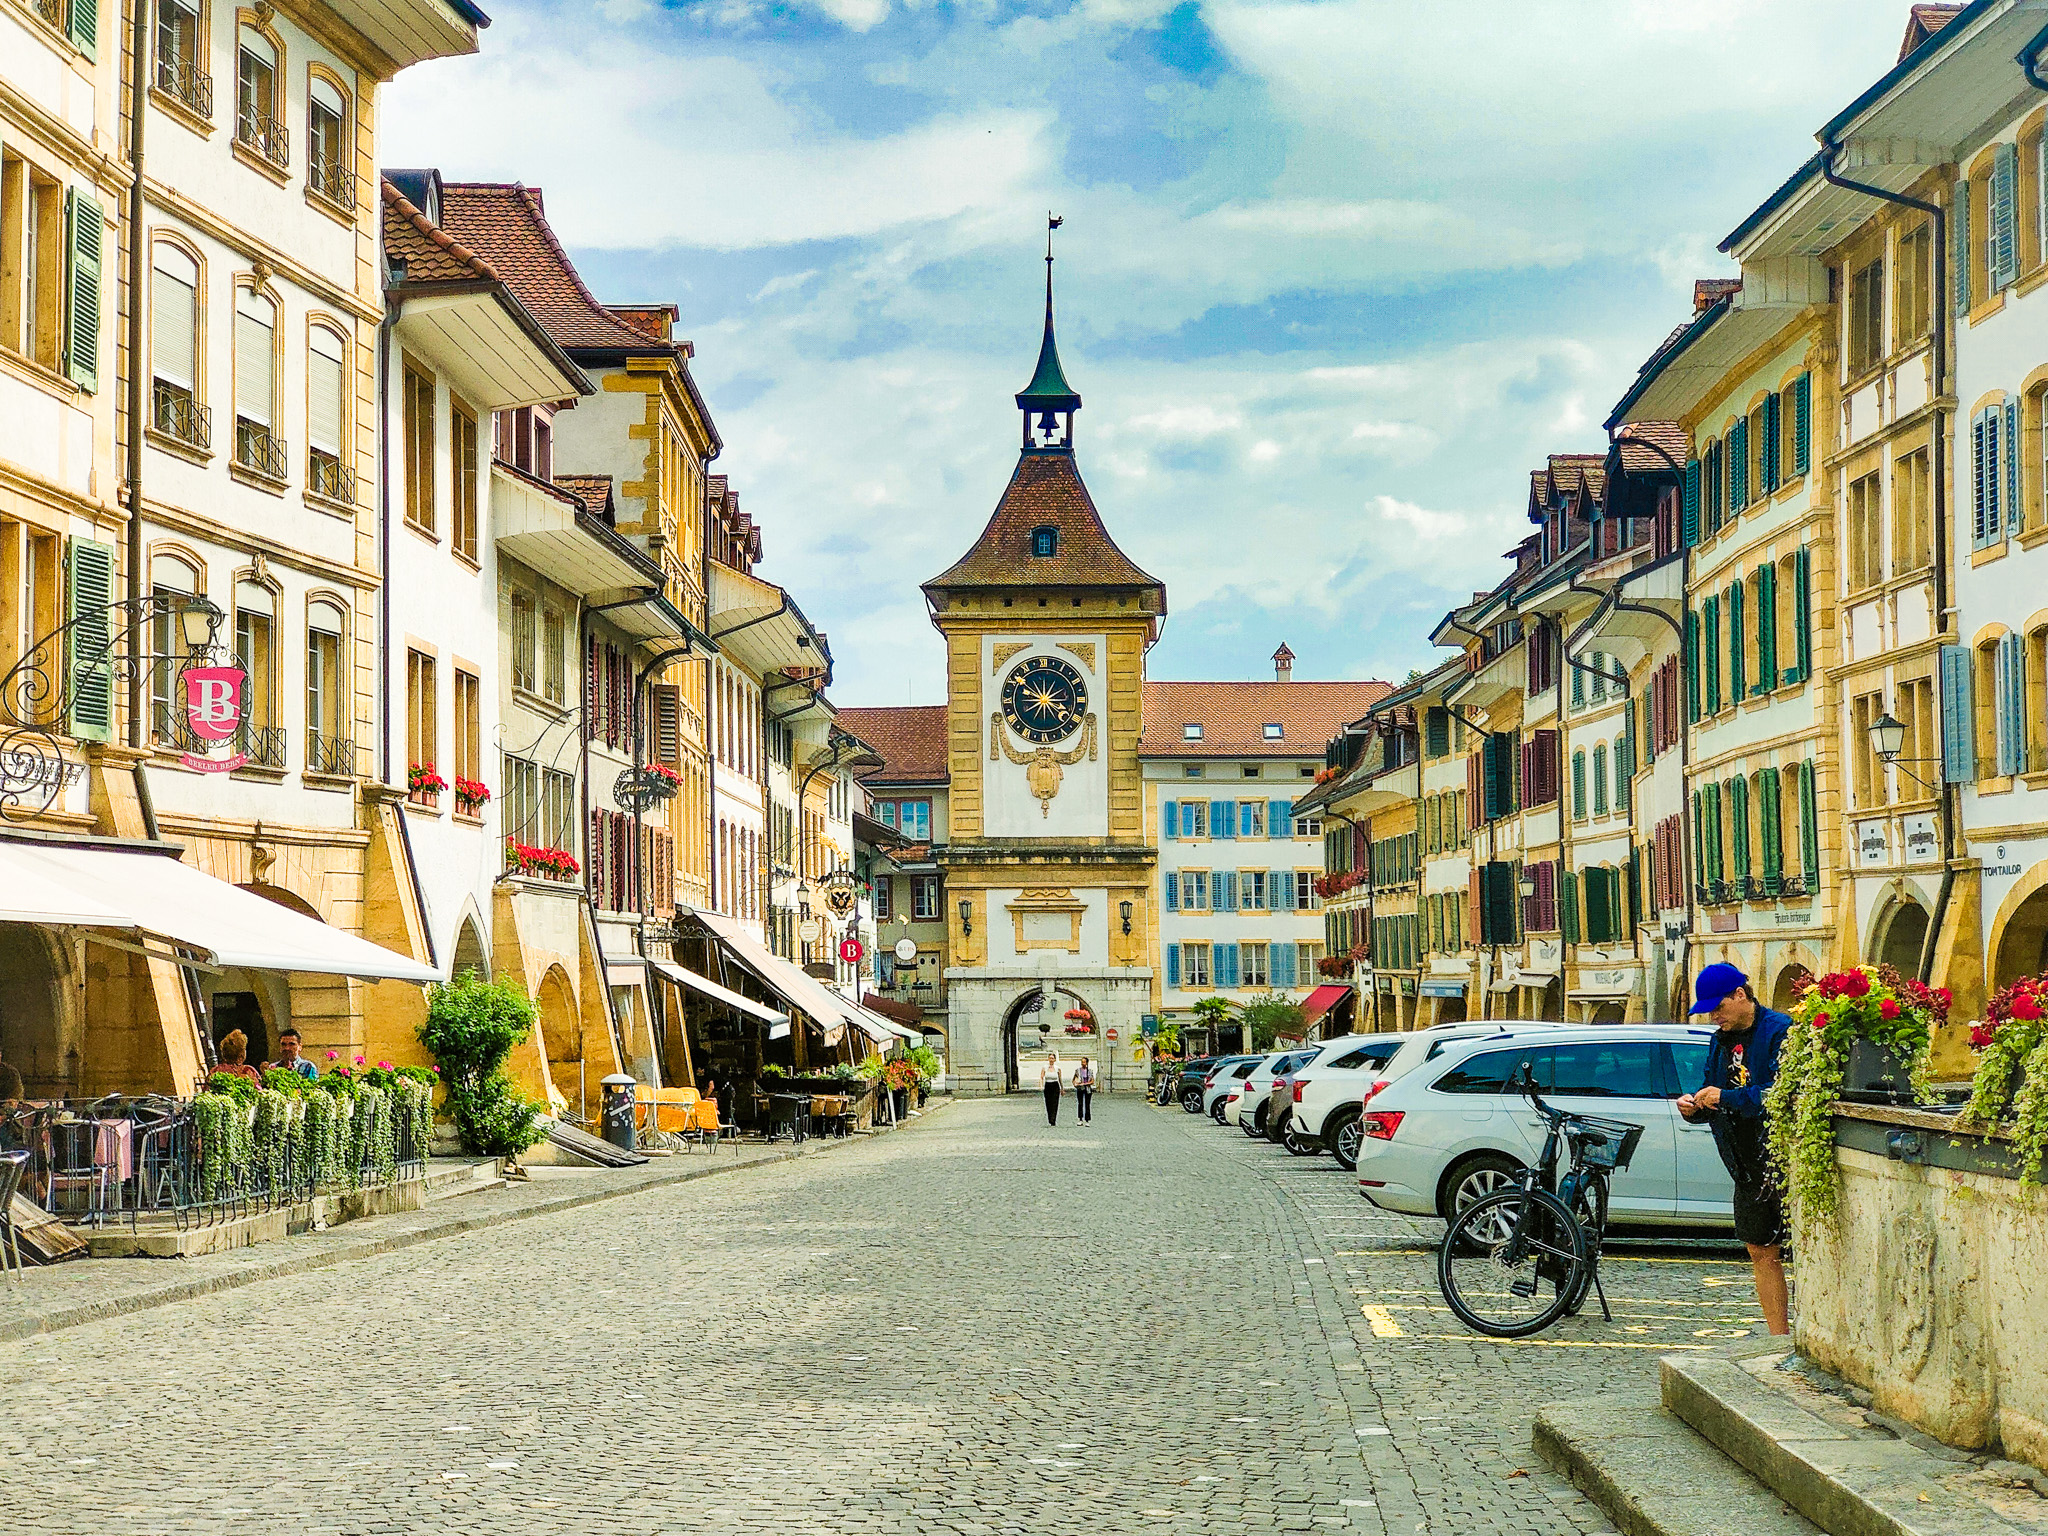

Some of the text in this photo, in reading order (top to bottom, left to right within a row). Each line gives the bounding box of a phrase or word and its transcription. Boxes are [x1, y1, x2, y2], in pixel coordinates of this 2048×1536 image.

[194, 679, 235, 722] B
[188, 758, 241, 770] BEELER BERN
[1984, 864, 2022, 877] TOM TAILOR
[846, 943, 857, 958] B
